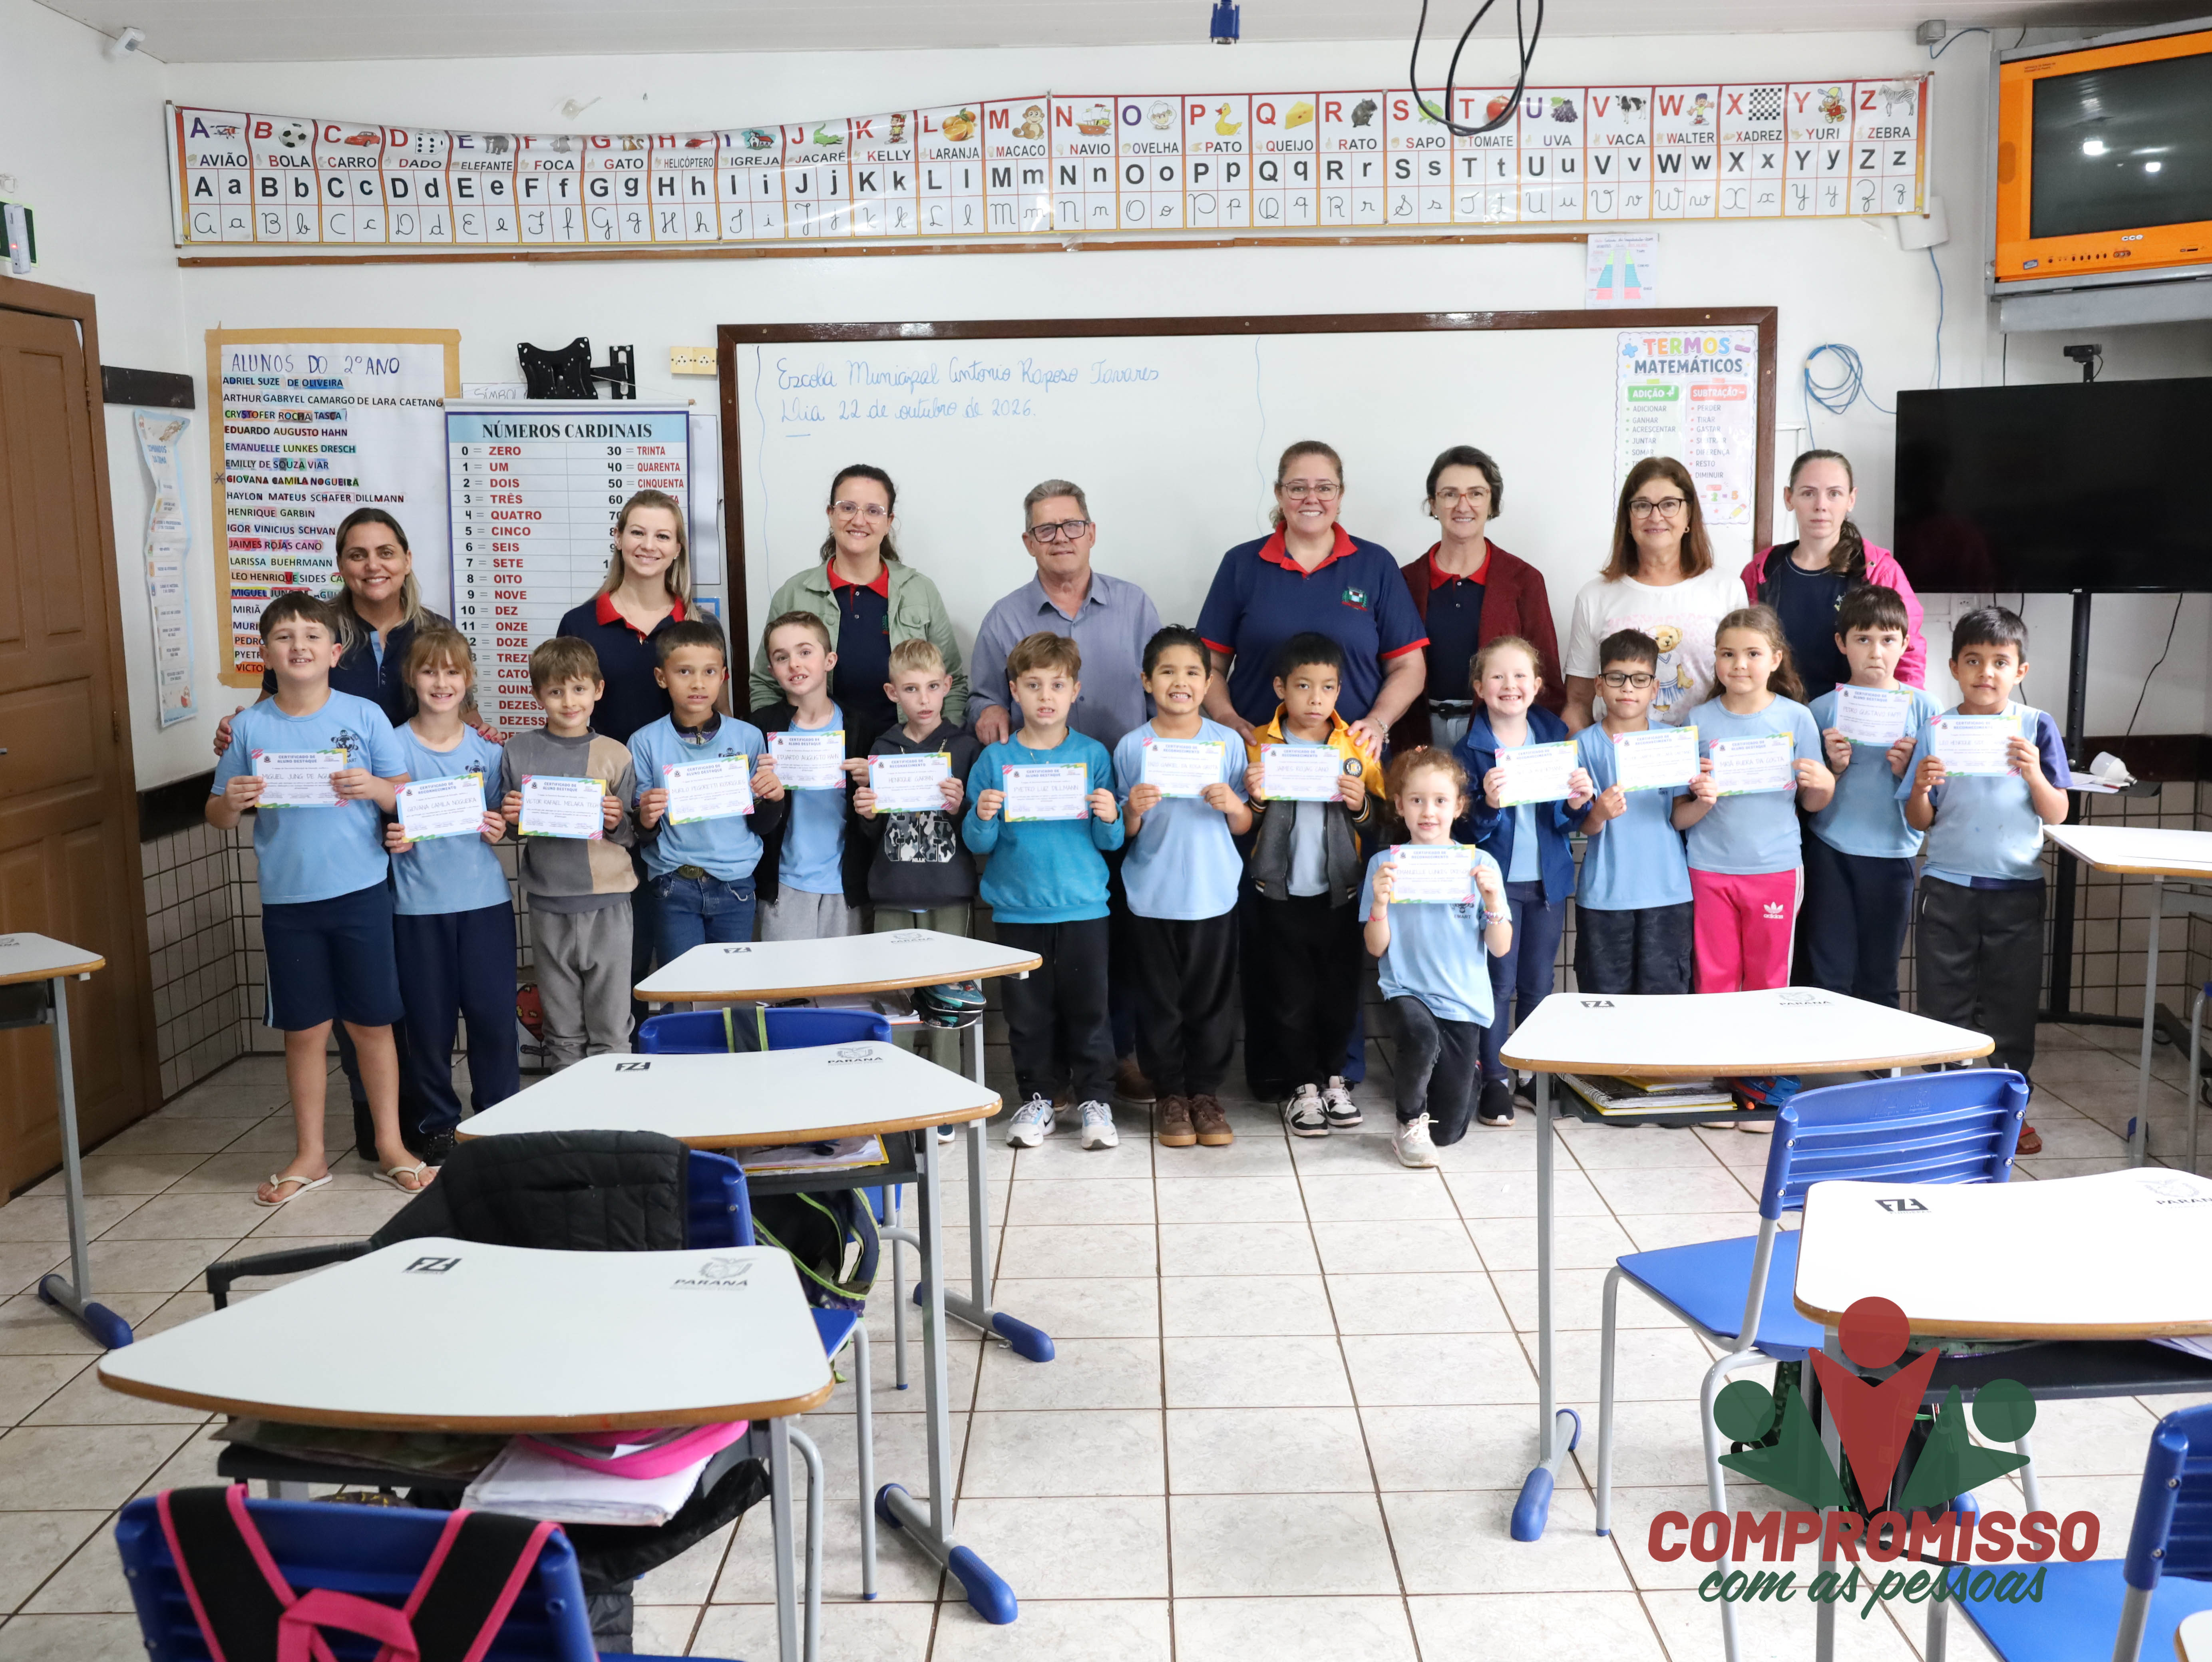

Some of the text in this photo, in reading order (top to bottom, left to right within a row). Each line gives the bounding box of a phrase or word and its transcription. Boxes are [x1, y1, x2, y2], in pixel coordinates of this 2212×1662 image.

[1667, 133, 1715, 144] WALTER
[1736, 130, 1782, 142] XADREZ
[1806, 129, 1839, 140] YURI
[1868, 127, 1910, 139] ZEBRA
[1339, 138, 1377, 150] RATO
[1406, 137, 1446, 149] SAPO
[1468, 136, 1514, 147] TOMATE
[1543, 135, 1571, 146] UVA
[1607, 134, 1645, 145] VACA
[996, 145, 1045, 158] MACACO
[1070, 144, 1110, 155] NAVIO
[1132, 142, 1179, 154] OVELHA
[1205, 142, 1242, 153] PATO
[1266, 140, 1314, 152] QUEIJO
[795, 151, 846, 164] JACARÉ
[867, 150, 911, 162] KELLY
[929, 147, 980, 160] LARANJA
[200, 152, 248, 167] AVIÃO
[269, 154, 311, 168] BOLA
[328, 157, 377, 168] CARRO
[399, 159, 442, 168] DADO
[604, 159, 644, 169] GATO
[664, 156, 714, 168] HELICÓPTERO
[730, 157, 779, 166] IGREJA
[461, 161, 513, 171] ELEFANTE
[534, 160, 575, 171] FOCA
[1643, 337, 1731, 356] TERMOS
[232, 353, 294, 373] ALUNOS
[308, 355, 328, 374] DO
[366, 358, 400, 375] ANO
[1634, 356, 1743, 374] MATEMÁTICOS
[777, 358, 837, 390] Escola
[949, 356, 1011, 383] Antonio
[1018, 358, 1078, 393] Raposo
[1090, 359, 1159, 384] Tavares
[223, 377, 256, 386] ADRIEL
[258, 378, 280, 386] SUZE
[302, 379, 343, 387] OLIVEIRA
[1632, 388, 1665, 399] ADIÇÃO
[1693, 387, 1738, 397] SUBTRAÇÃO
[224, 394, 261, 403] ARTHUR
[263, 394, 304, 403] GABRYEL
[308, 396, 355, 404] CAMARGO
[372, 398, 396, 406] LARA
[839, 399, 861, 420] 22
[867, 398, 889, 417] de
[895, 397, 957, 420] outubro
[963, 397, 983, 418] de
[225, 410, 341, 420] CRYSTOFER ROCHA TASCA
[225, 426, 270, 435] EDUARDO
[274, 428, 318, 436] AUGUSTO
[482, 420, 652, 438] NÚMEROS CARDINAIS
[226, 443, 355, 453] EMANUELLE LUNKES DRESCH
[462, 446, 521, 456] 0 ZERO
[607, 446, 665, 455] 30 TRINTA
[226, 460, 329, 469] EMILLY DE SOUZA VIAR
[463, 463, 509, 471] 1 UM
[608, 462, 680, 472] 40 QUARENTA
[227, 475, 269, 484] GIOVANA
[310, 478, 359, 487] NOGUEIRA
[463, 478, 520, 488] 2 DOIS
[608, 478, 684, 489] 50 CINQUENTA
[227, 492, 404, 503] HAYLON MATEUS SCHAFER DILLMANN
[464, 491, 523, 504] 3 TRÊS
[228, 508, 315, 517] HENRIQUE GARBIN
[465, 511, 542, 521] 4 QUATRO
[227, 524, 335, 535] IGOR VINICIUS SCHVAN
[465, 526, 531, 536] 5 CINCO
[229, 540, 322, 551] JAIMES ROJAS CANO
[466, 542, 519, 552] 6 SEIS
[271, 558, 332, 567] BUEHRMANN
[466, 558, 523, 568] 7 SETE
[250, 573, 298, 582] HENRIQUE
[299, 574, 326, 582] SIDES
[467, 574, 522, 584] 8 OITO
[231, 588, 267, 597] MIGUEL
[467, 590, 527, 600] 9 NOVE
[233, 604, 261, 614] MIRIÃ
[461, 606, 518, 616] 10 DEZ
[461, 622, 528, 632] 11 ONZE
[496, 637, 528, 648] DOZE
